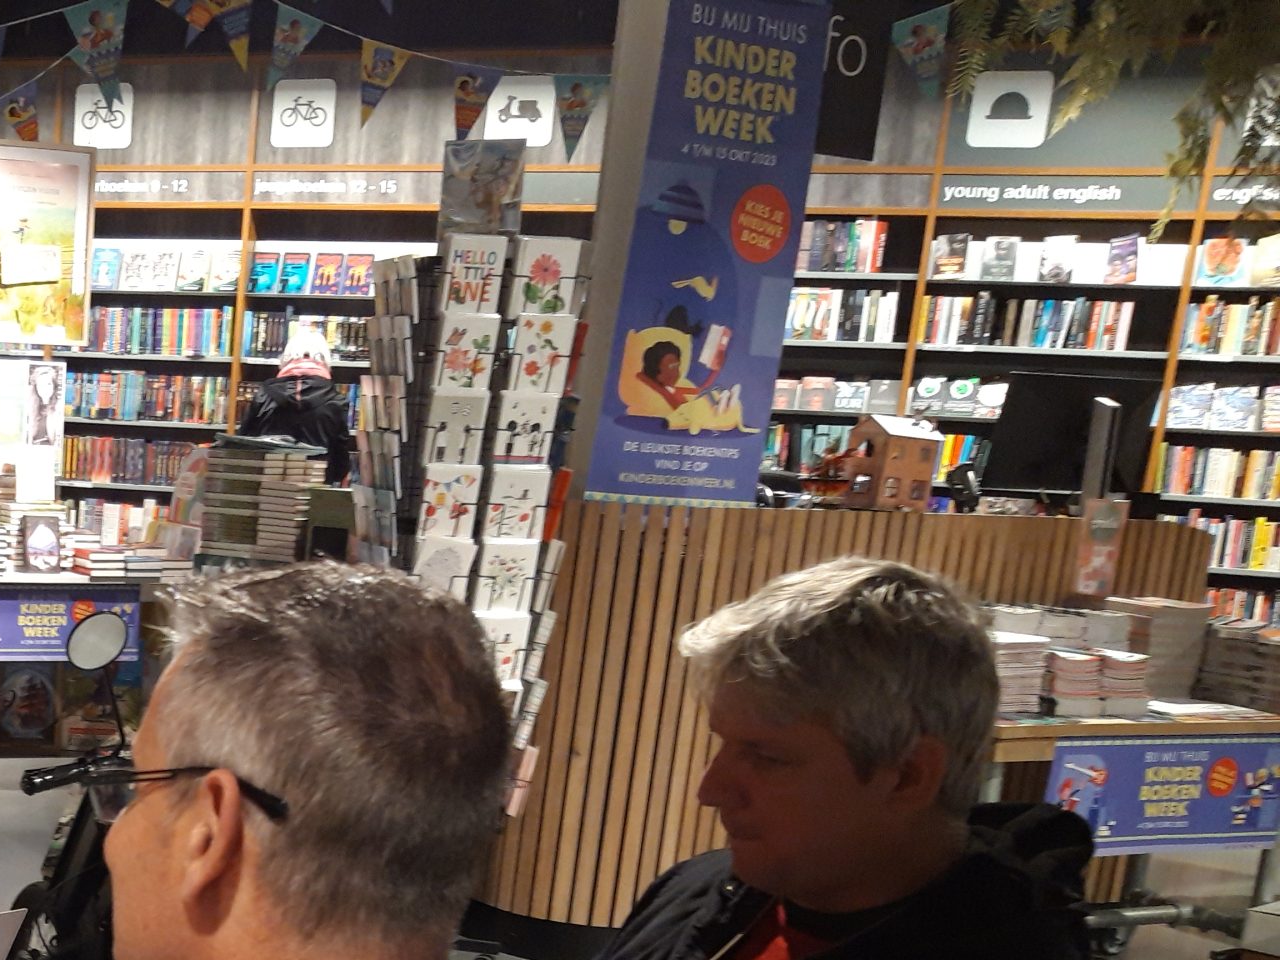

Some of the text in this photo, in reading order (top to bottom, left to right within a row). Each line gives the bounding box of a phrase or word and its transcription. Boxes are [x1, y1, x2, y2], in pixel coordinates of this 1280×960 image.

[757, 15, 807, 44] THUIS
[823, 14, 867, 76] fo
[694, 35, 797, 80] KINDER
[684, 69, 797, 115] BOEKEN
[694, 104, 776, 144] WEEK
[171, 180, 189, 193] 12
[378, 180, 397, 194] 15
[943, 184, 1122, 204] young adult english
[740, 229, 774, 250] BOEK
[453, 249, 497, 265] HELLO
[19, 603, 67, 614] KINDER
[17, 615, 68, 626] BOEKEN
[22, 626, 60, 637] WEEK
[1145, 766, 1204, 782] KINDER
[1139, 784, 1202, 801] BOEKEN
[1144, 801, 1190, 818] WEEK
